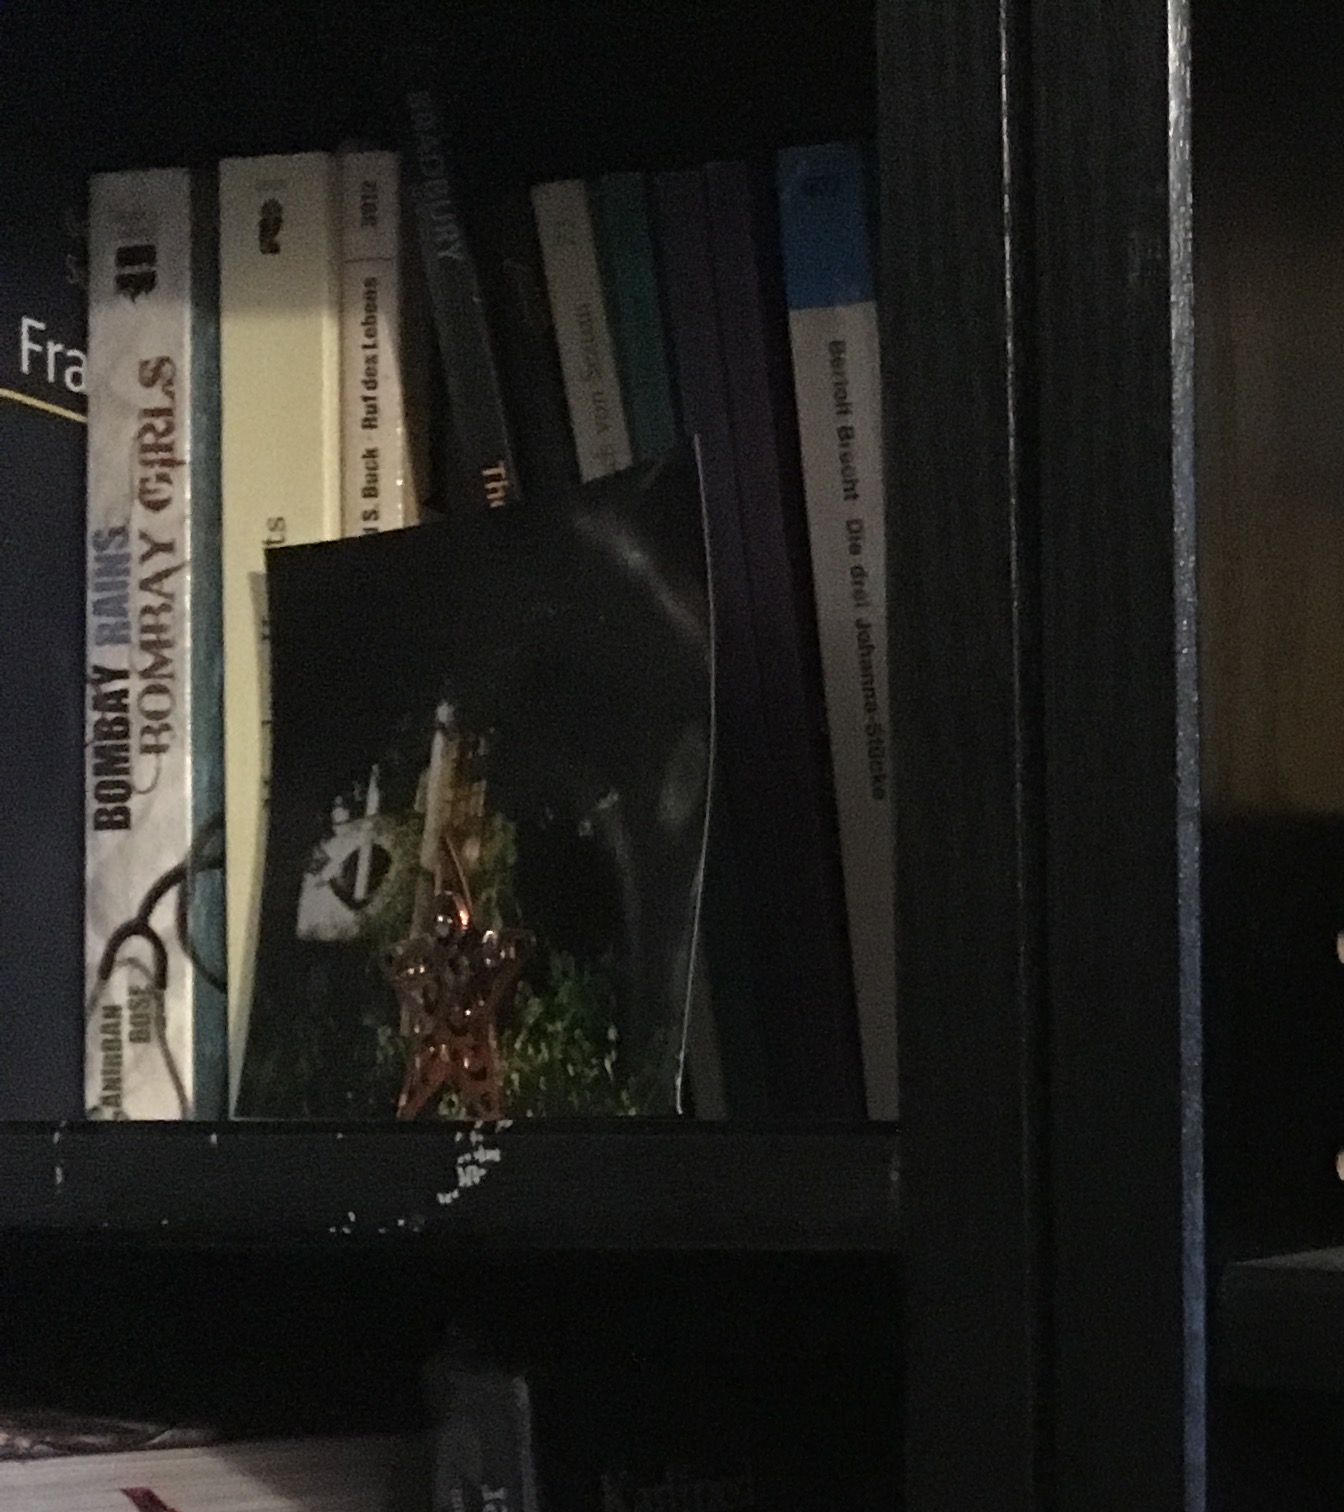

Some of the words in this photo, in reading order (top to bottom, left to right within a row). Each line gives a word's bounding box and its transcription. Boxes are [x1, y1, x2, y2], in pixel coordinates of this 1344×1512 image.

[361, 277, 379, 350] Lebens
[362, 355, 379, 391] des
[137, 356, 185, 512] GIRLS
[361, 394, 380, 430] Ruf
[362, 448, 380, 498] Buck
[836, 425, 863, 501] Brecht
[843, 518, 868, 557] Die
[93, 526, 131, 647] RAINS
[847, 564, 872, 609] drei
[134, 527, 186, 790] BOMBAY
[93, 665, 131, 830] BOMBAY
